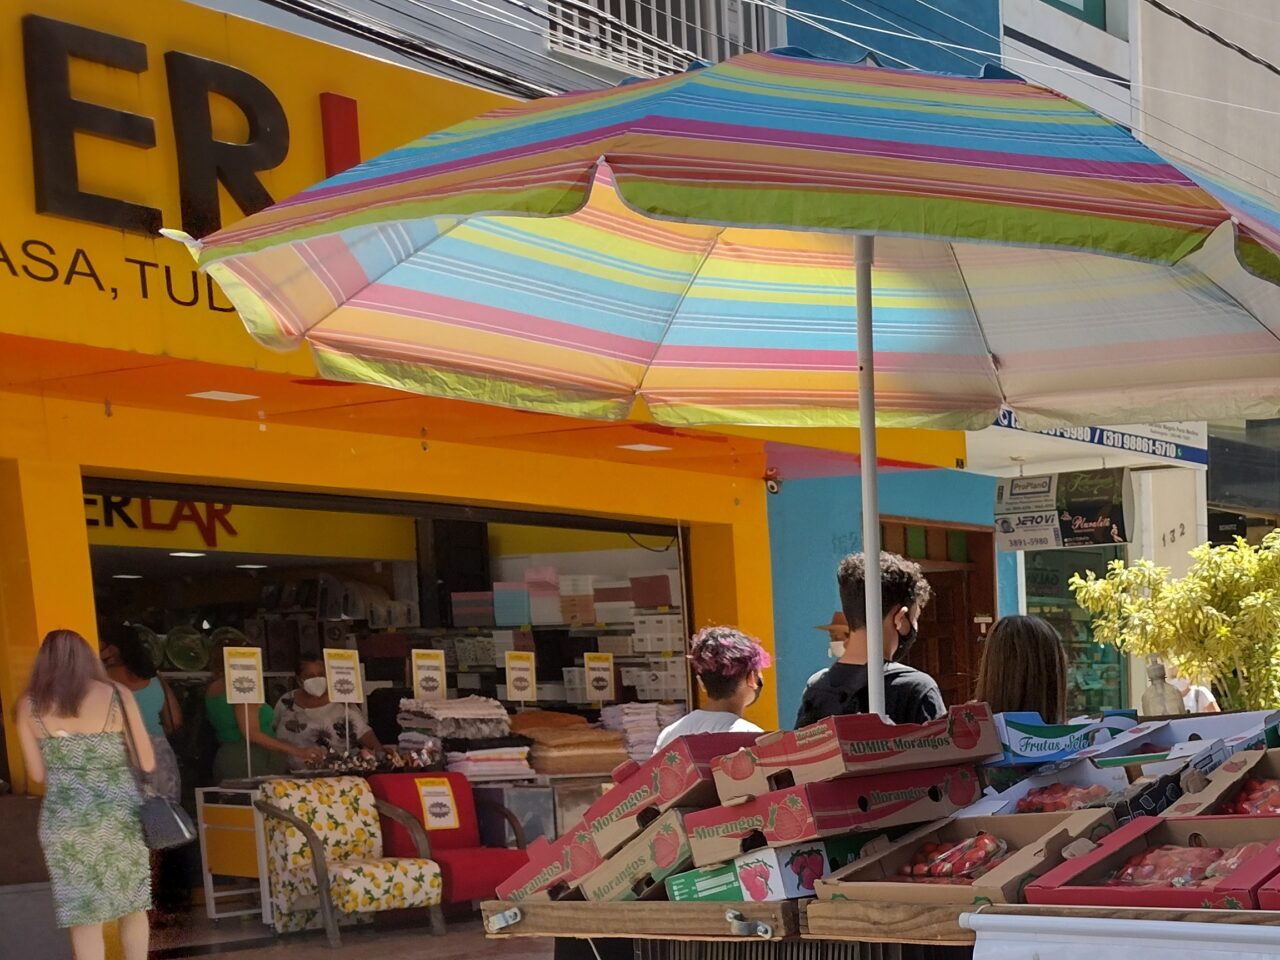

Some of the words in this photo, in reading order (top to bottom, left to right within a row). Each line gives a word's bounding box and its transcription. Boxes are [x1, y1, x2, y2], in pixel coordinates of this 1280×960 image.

[1162, 522, 1186, 548] 132
[893, 735, 950, 750] Morangos
[1020, 736, 1060, 752] Frutas
[871, 786, 929, 804] Morangos
[591, 784, 650, 835] Morangos
[694, 814, 765, 841] Morangos
[508, 860, 562, 901] Morangos
[592, 854, 647, 900] Morangos
